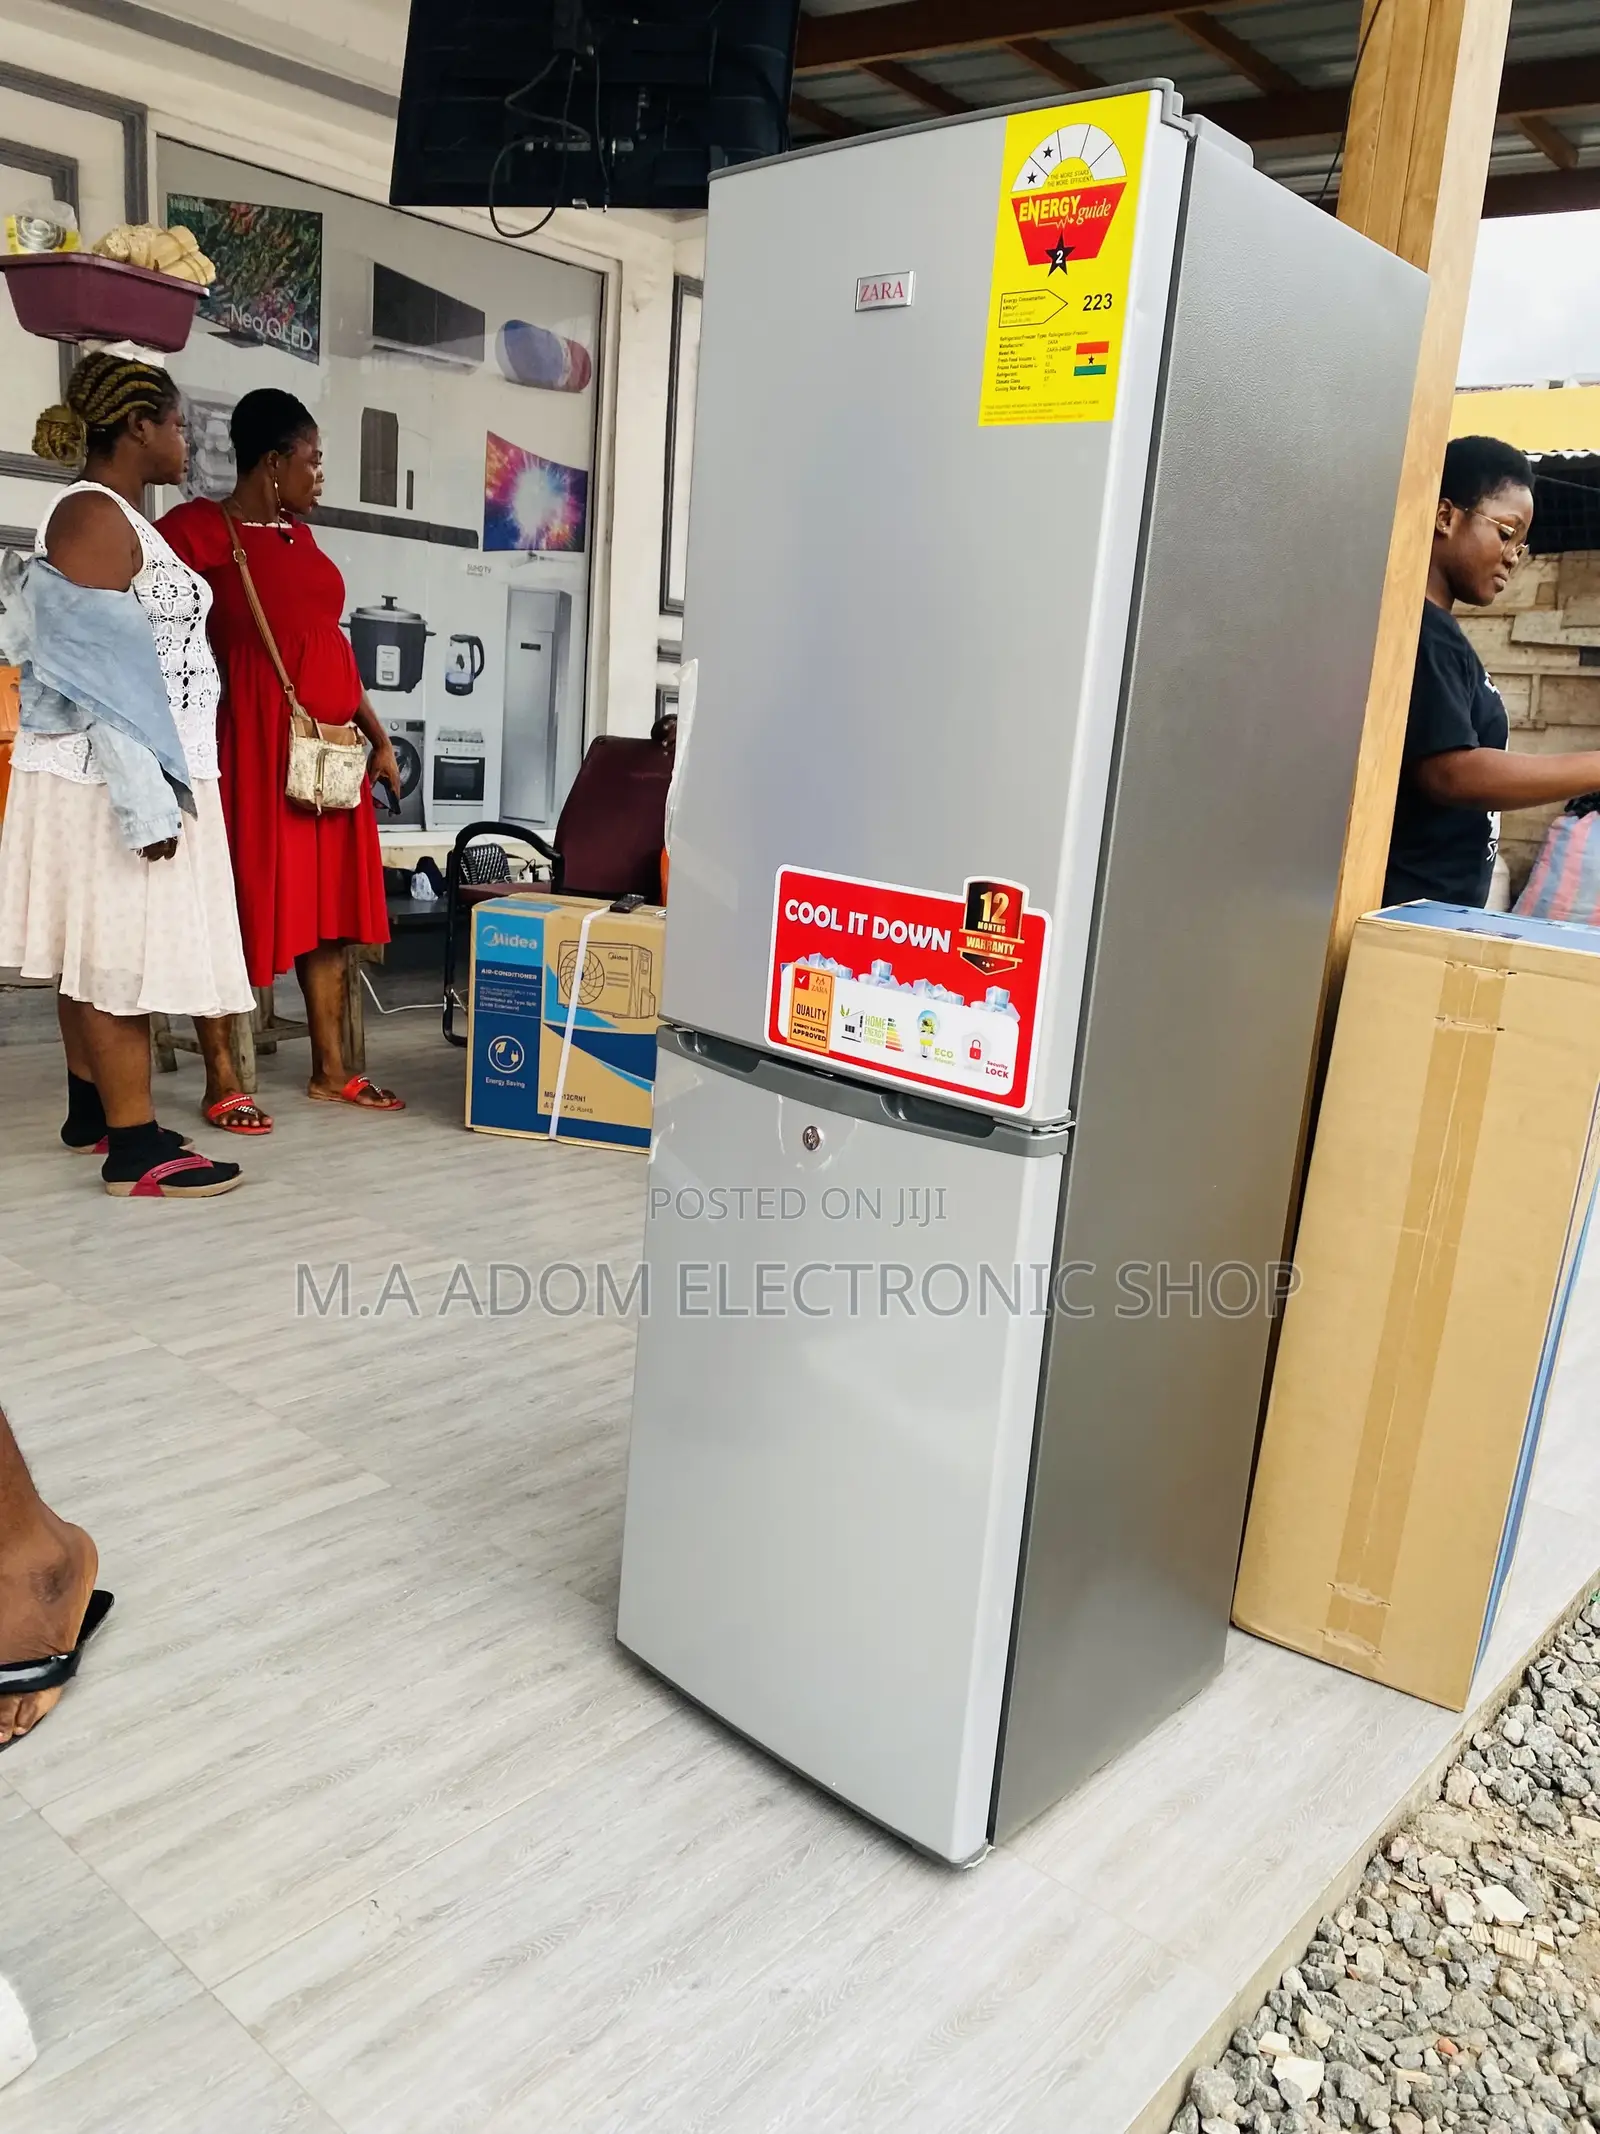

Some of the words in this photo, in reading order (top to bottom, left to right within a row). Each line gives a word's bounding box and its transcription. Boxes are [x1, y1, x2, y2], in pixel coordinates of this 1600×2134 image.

[1056, 178, 1068, 186] MORE
[1018, 195, 1081, 227] ENERGY
[1077, 198, 1111, 224] guide
[1055, 250, 1064, 264] 2
[860, 280, 904, 302] ZARA
[1082, 293, 1113, 311] 223
[230, 304, 264, 333] Neo
[266, 317, 312, 350] QLED
[980, 891, 1010, 924] 12
[784, 898, 843, 931] COOL
[848, 911, 868, 936] IT
[872, 916, 952, 954] DOWN
[978, 920, 1006, 934] MONTHS
[484, 928, 538, 949] Midea
[966, 936, 1016, 955] WARRANTY
[481, 968, 538, 980] AIR-CONDITIONER
[796, 1003, 826, 1021] QUALITY
[794, 1022, 810, 1030] ENERGY
[865, 1014, 886, 1030] HOME
[793, 1028, 826, 1042] APPROVED
[934, 1048, 954, 1058] ECO
[986, 1060, 1008, 1070] Security
[986, 1067, 1009, 1078] LOCK
[486, 1076, 505, 1086] Energy
[506, 1080, 526, 1089] Saving
